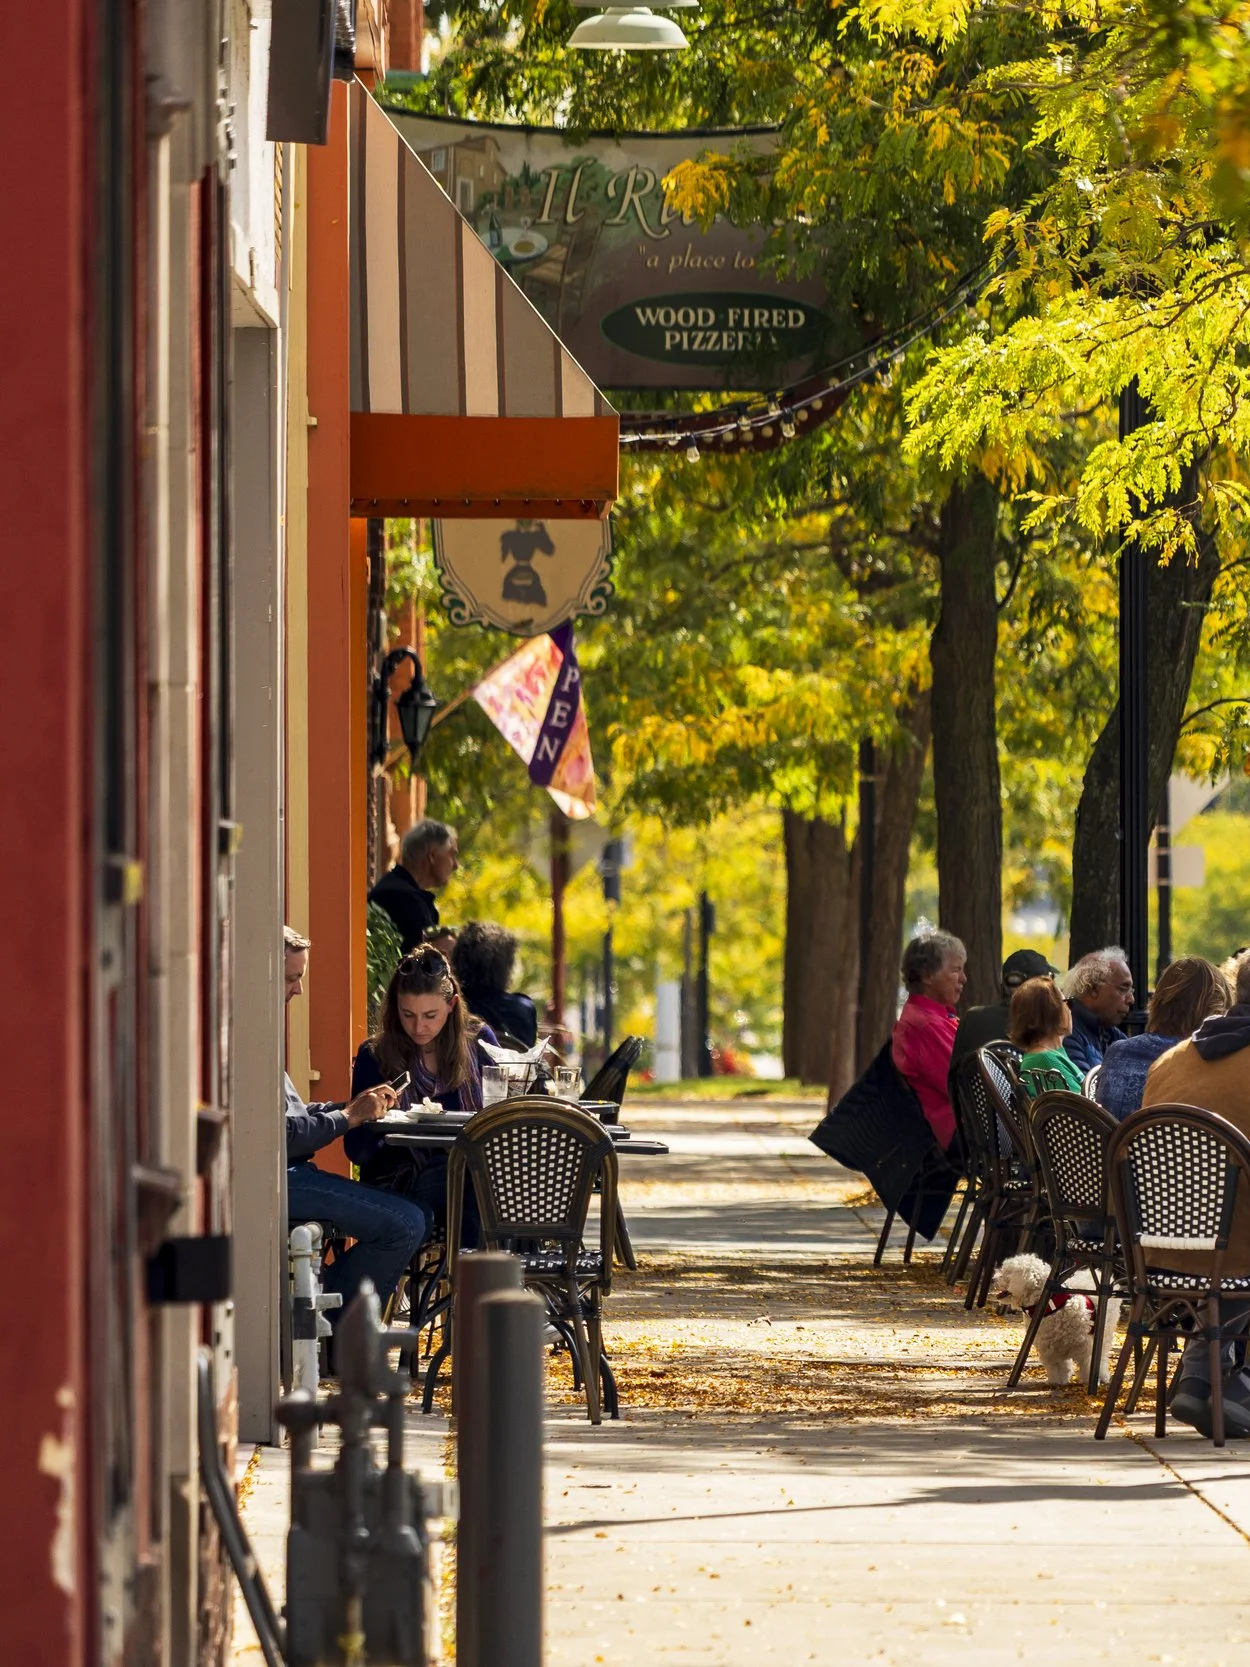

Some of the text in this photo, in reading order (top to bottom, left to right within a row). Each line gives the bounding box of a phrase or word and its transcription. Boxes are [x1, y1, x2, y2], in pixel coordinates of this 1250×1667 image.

[536, 160, 598, 225] Il
[668, 243, 726, 274] place
[734, 251, 755, 269] to
[635, 307, 806, 329] WOOD FIRED
[537, 666, 580, 761] PEN
